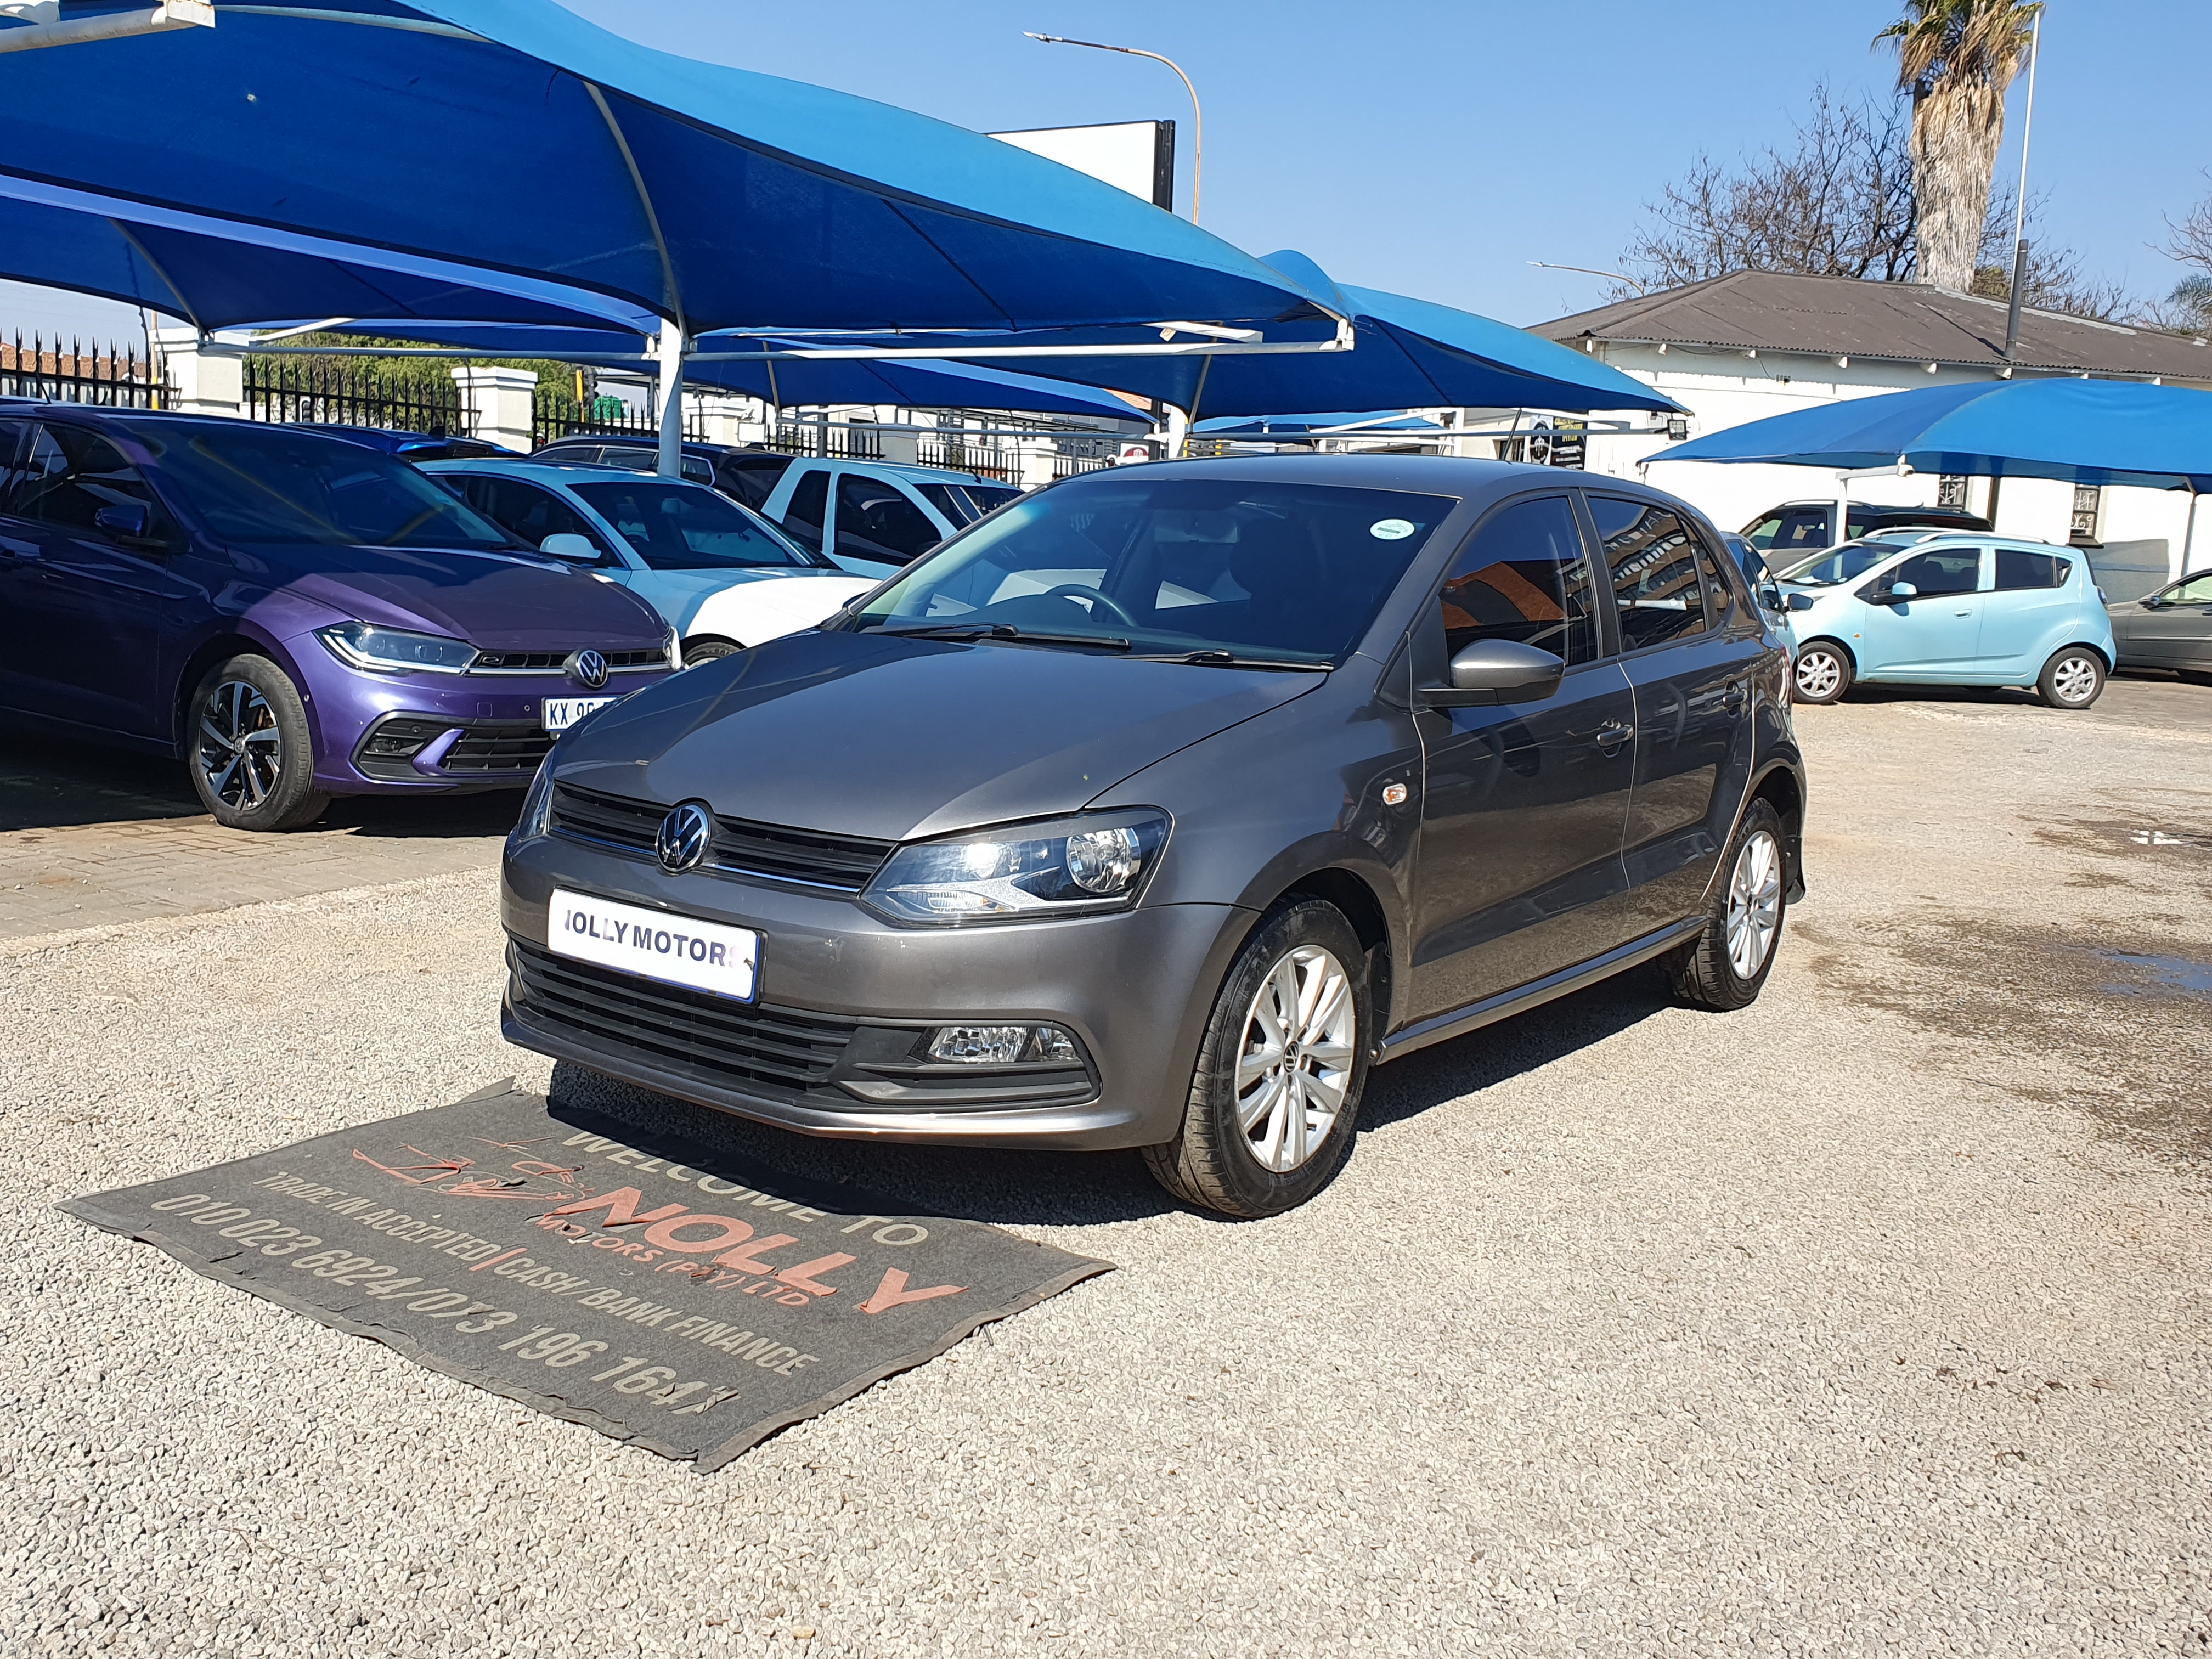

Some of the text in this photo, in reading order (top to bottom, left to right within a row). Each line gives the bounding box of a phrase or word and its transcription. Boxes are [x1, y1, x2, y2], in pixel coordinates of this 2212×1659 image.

[550, 702, 568, 726] KX
[633, 924, 744, 969] MOTORS
[561, 1131, 929, 1245] WELCOME TO
[150, 1193, 252, 1225] 010
[218, 1218, 323, 1256] 023
[497, 1324, 609, 1368] 196
[253, 1171, 349, 1204] TRADE
[325, 1196, 379, 1215] IN
[352, 1208, 502, 1261] ACCEPTED
[663, 1315, 821, 1376] FINANCE
[544, 1186, 969, 1314] NOLLY
[742, 1280, 810, 1306] LTD
